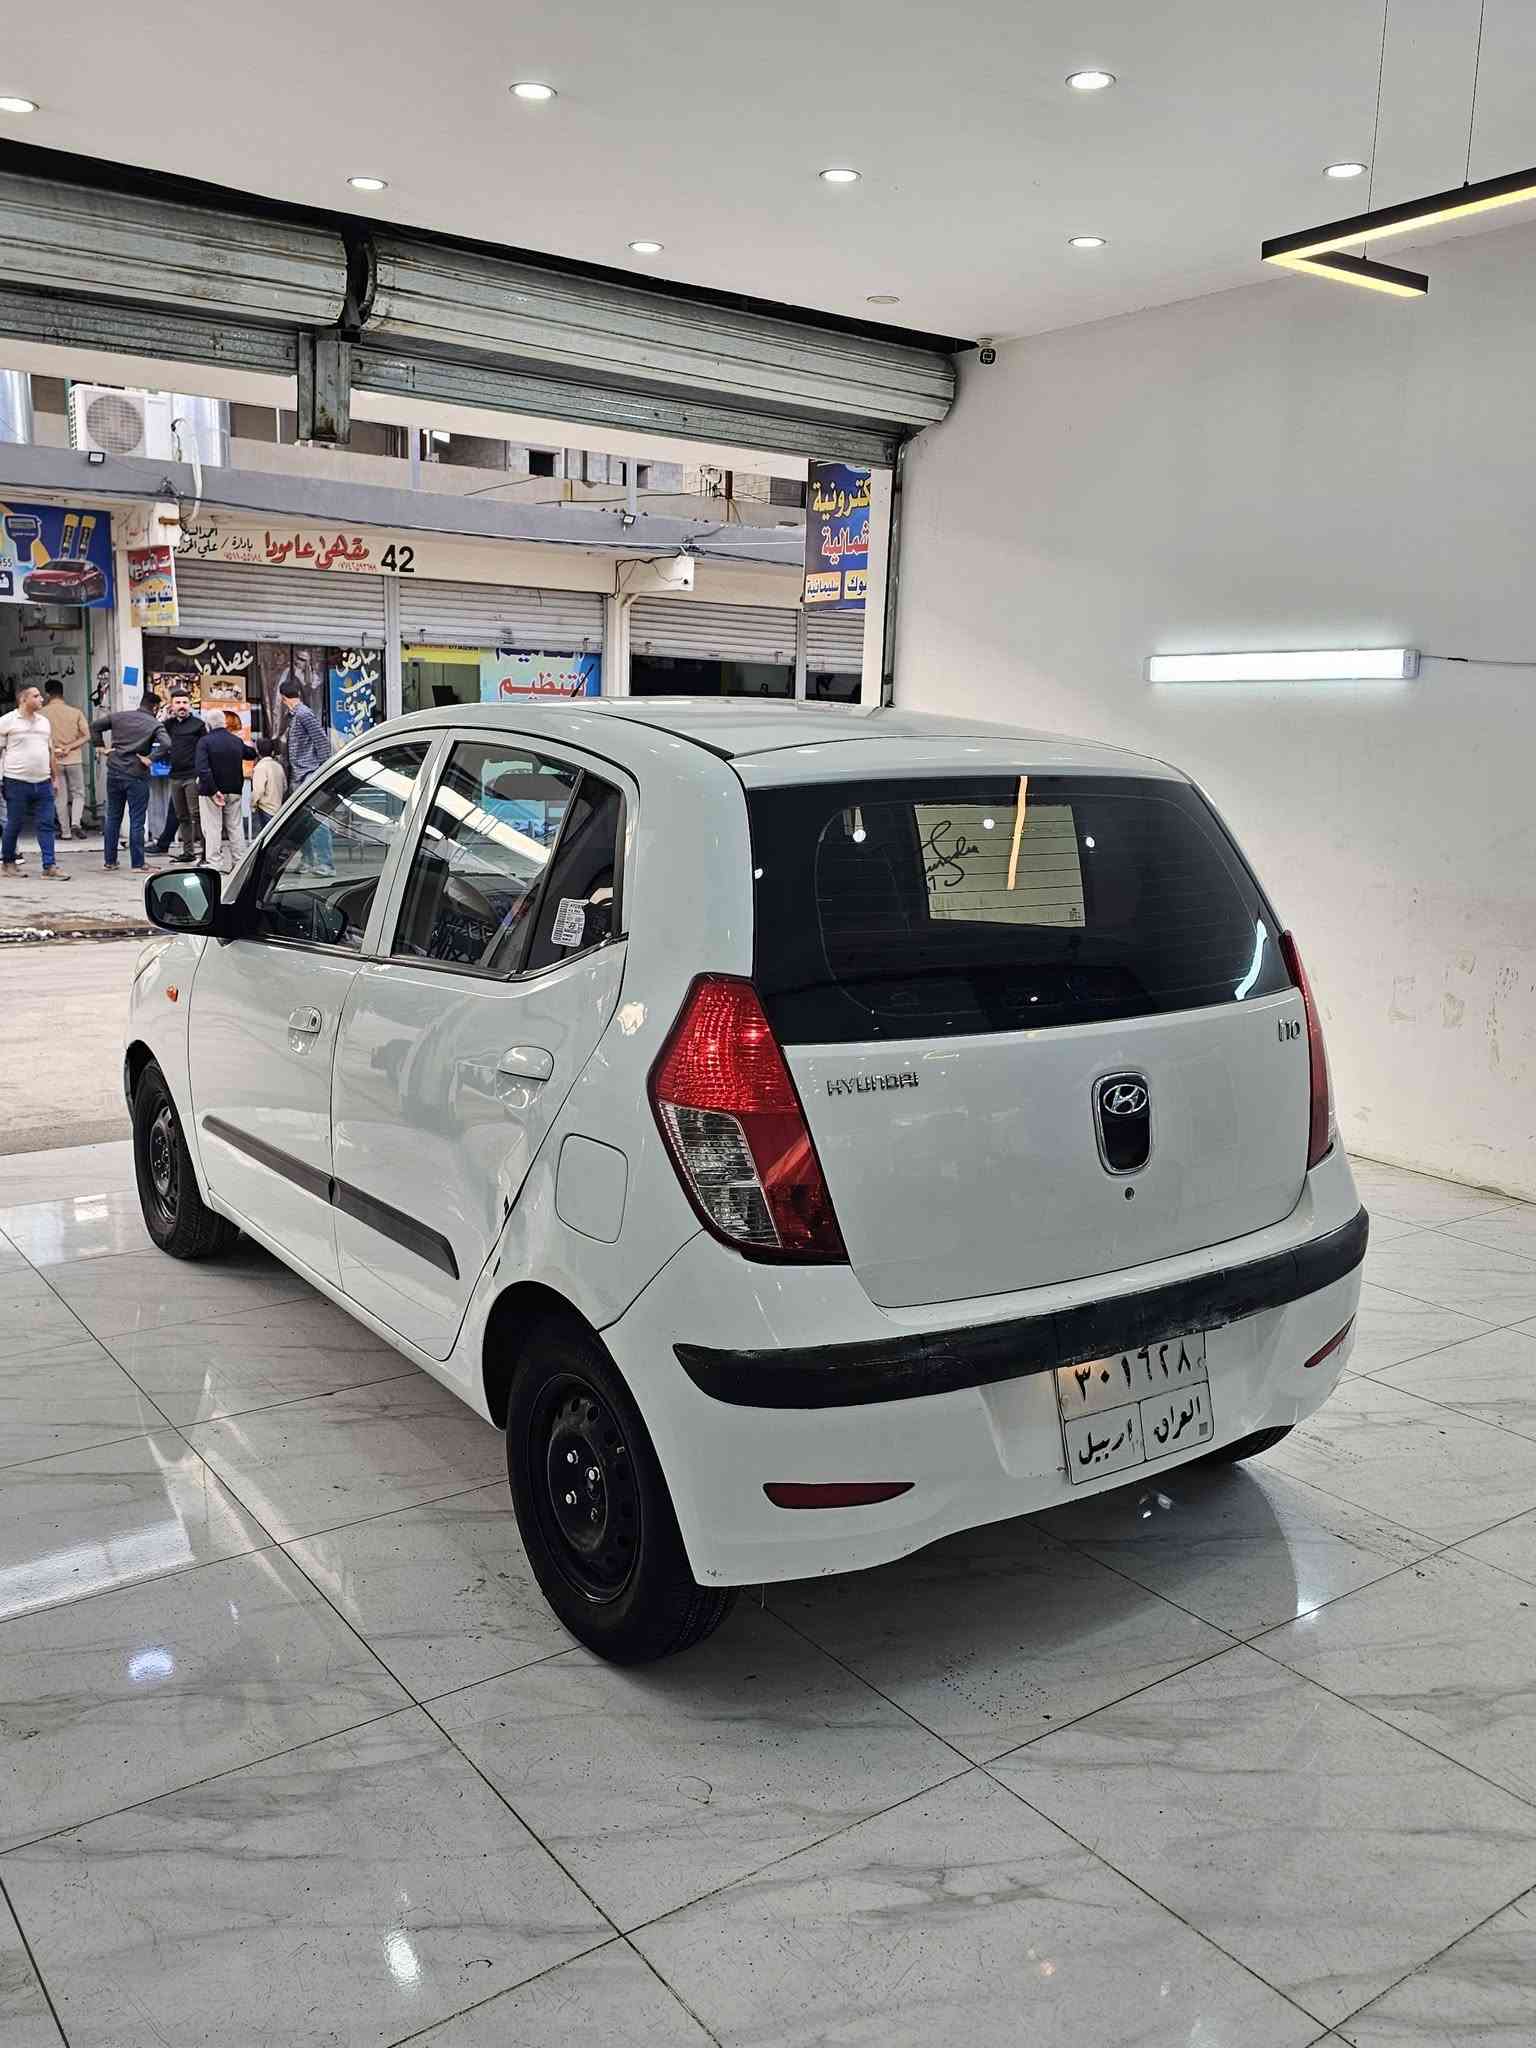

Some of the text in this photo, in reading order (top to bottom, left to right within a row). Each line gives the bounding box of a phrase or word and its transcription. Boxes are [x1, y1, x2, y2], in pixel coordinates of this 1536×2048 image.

[381, 544, 415, 573] 42
[826, 1071, 920, 1097] HYUNDAI
[1153, 1395, 1202, 1444] العراق
[1078, 1417, 1134, 1466] اربيل
